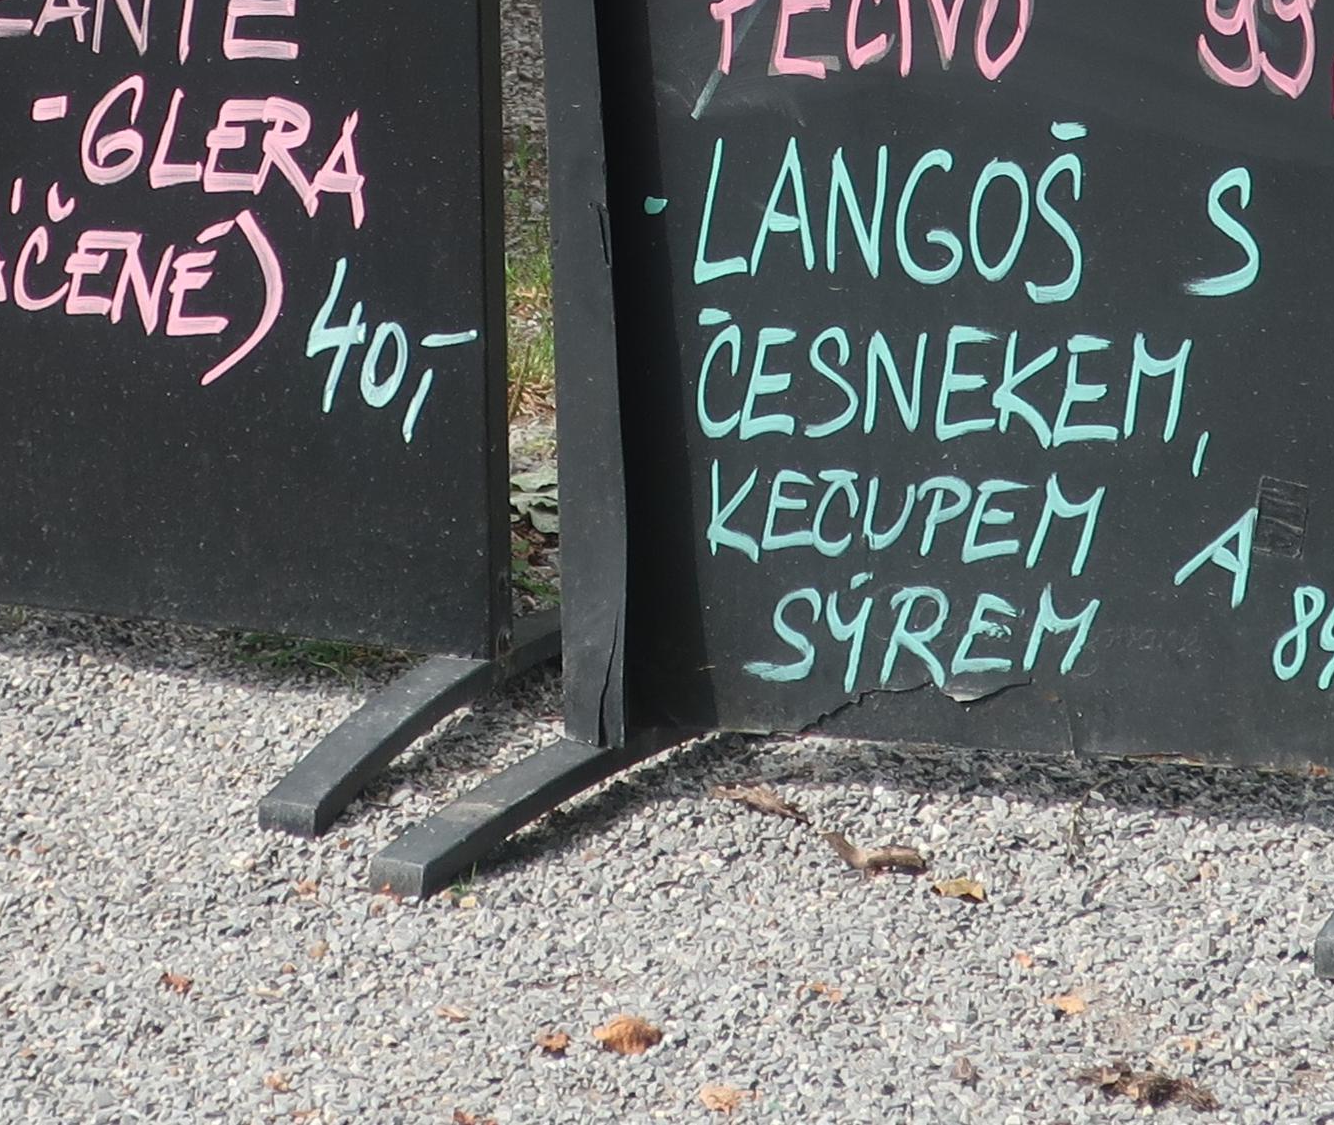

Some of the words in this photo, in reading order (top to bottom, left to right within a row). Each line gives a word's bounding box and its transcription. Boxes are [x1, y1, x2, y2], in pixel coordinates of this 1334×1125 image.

[694, 122, 1087, 304] LANGOŠ
[1182, 167, 1260, 297] S
[696, 309, 1210, 477] ČESNEKEM,
[708, 459, 1105, 577] KEČUPEM
[1174, 508, 1259, 607] A
[742, 572, 1100, 693] SÝREM
